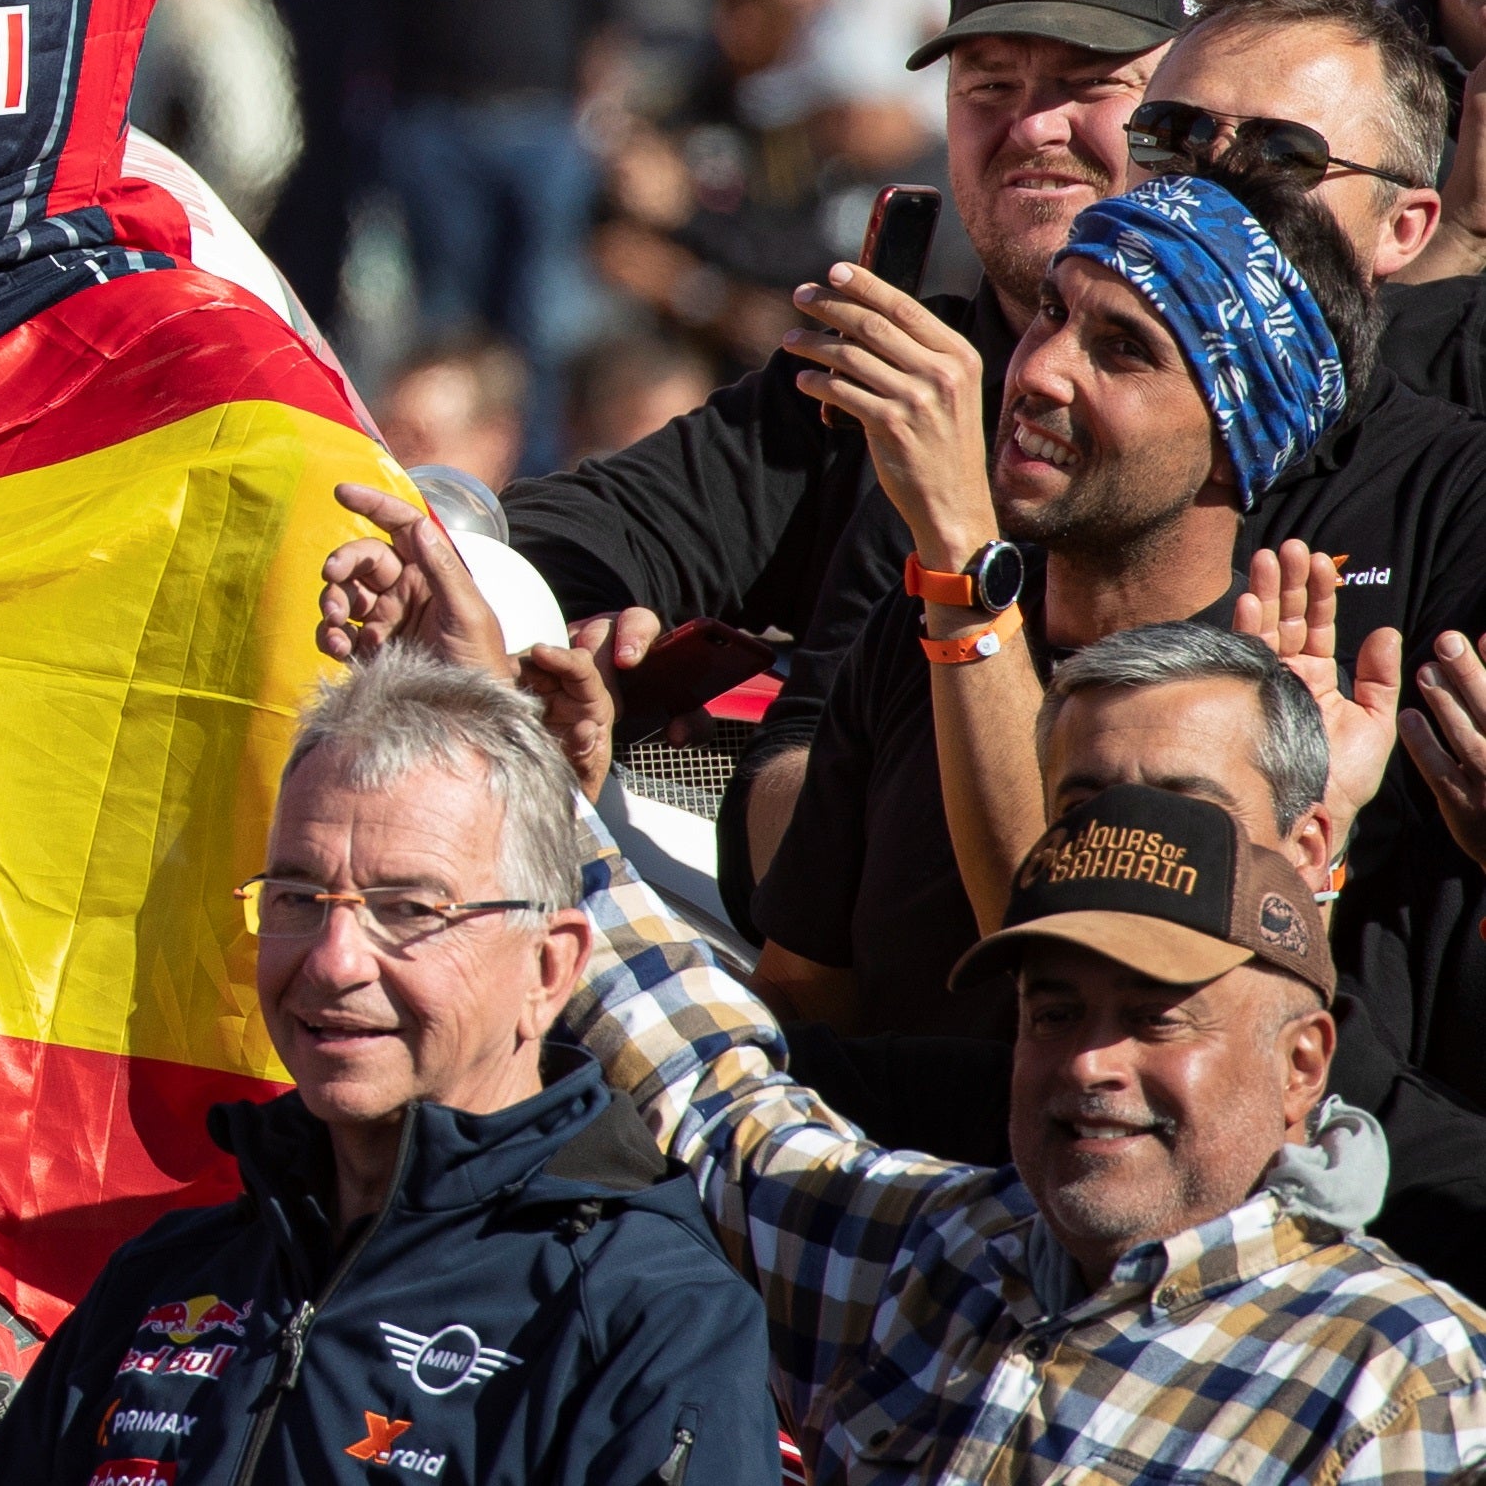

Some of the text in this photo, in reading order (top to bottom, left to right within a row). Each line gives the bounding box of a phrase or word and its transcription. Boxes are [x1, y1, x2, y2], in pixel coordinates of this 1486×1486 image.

[421, 1348, 471, 1372] MINI
[112, 1410, 197, 1436] PRIMAX
[343, 1409, 447, 1477] X-raid
